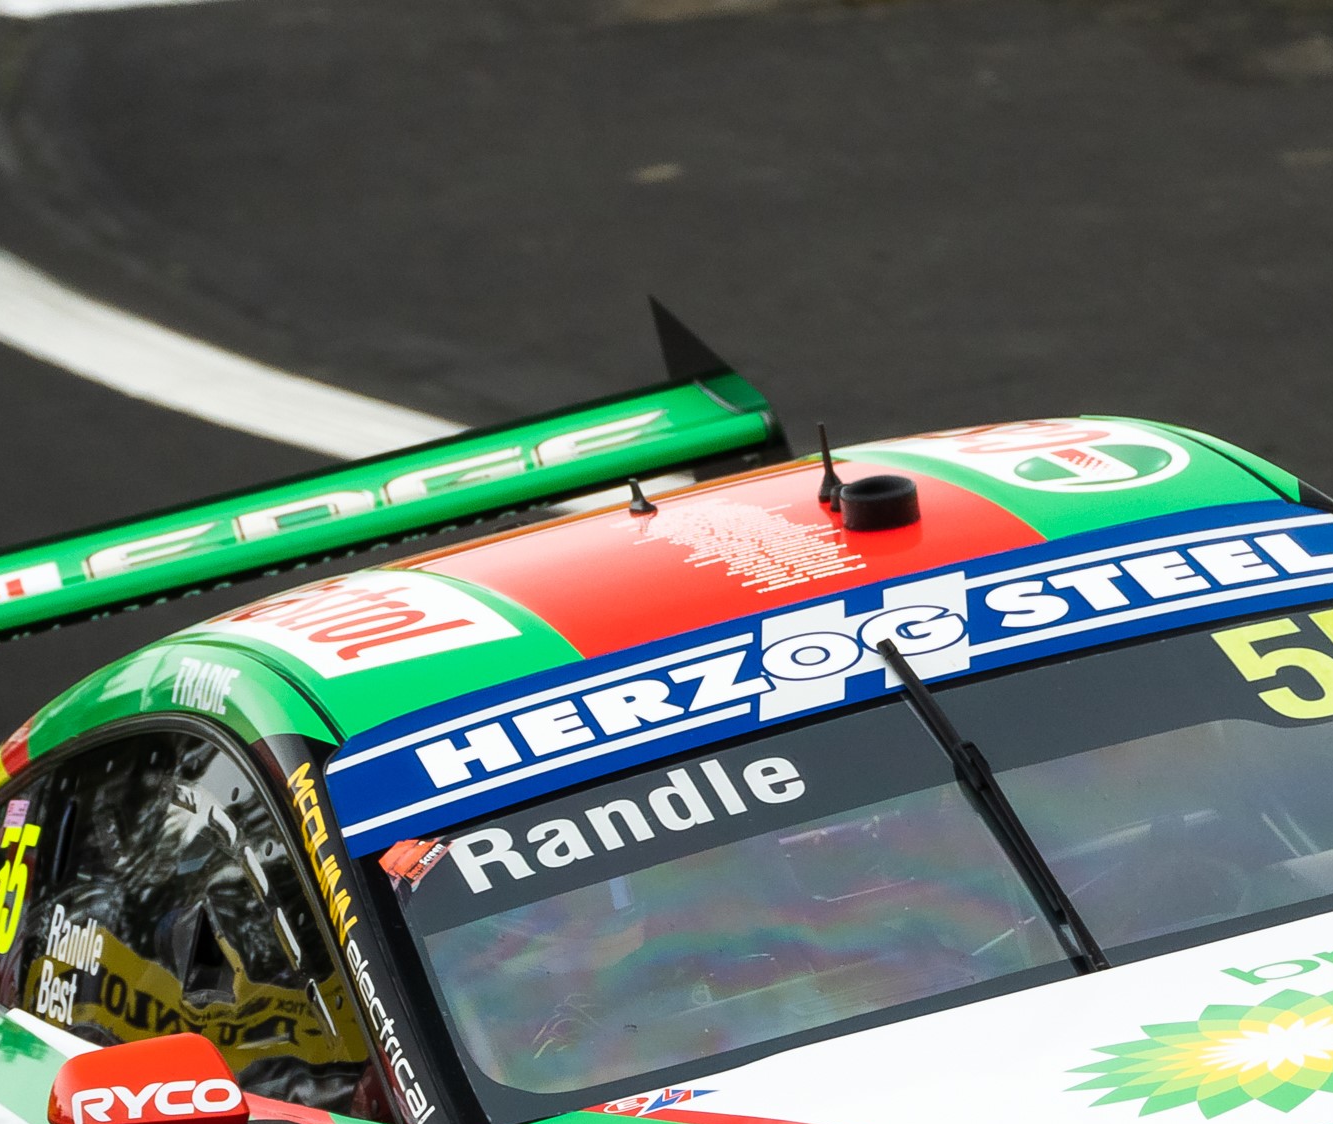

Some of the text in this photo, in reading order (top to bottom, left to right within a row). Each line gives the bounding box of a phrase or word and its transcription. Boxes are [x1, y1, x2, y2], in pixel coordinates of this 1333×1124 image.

[171, 656, 241, 716] TRADIE
[415, 604, 967, 789] HERZOG
[447, 755, 806, 895] Randle
[43, 903, 104, 977] Randle
[36, 958, 78, 1026] Best
